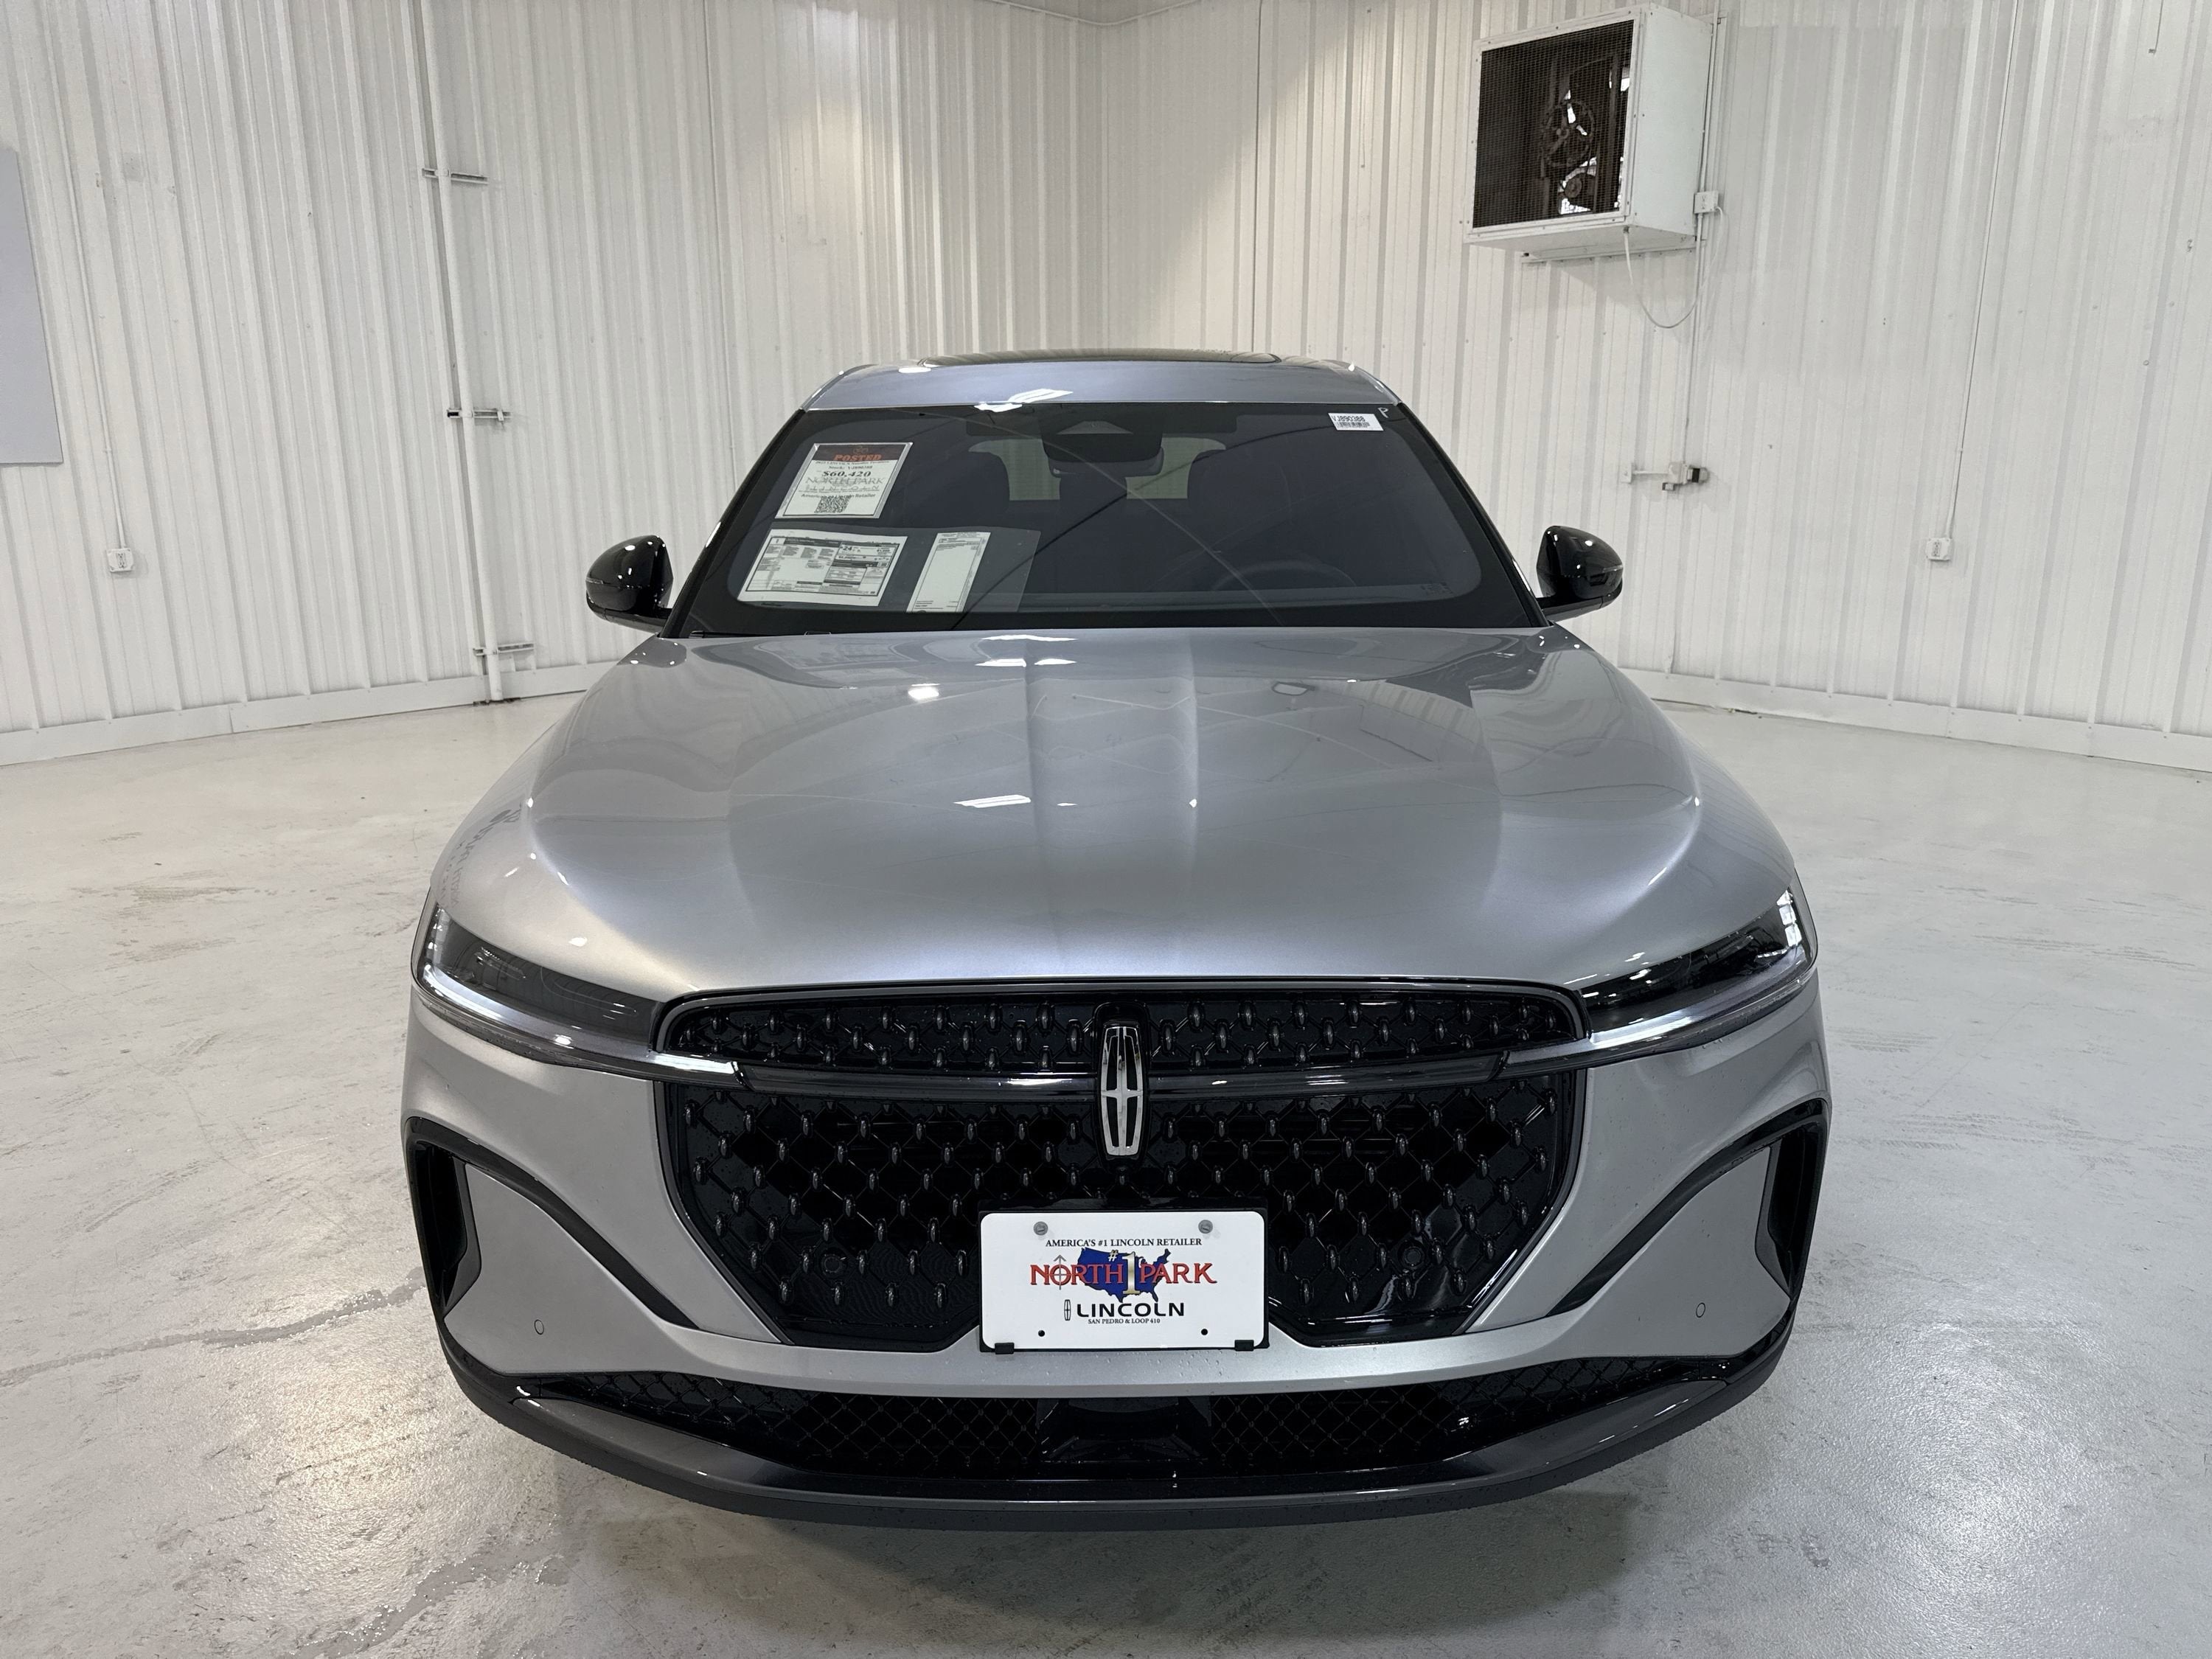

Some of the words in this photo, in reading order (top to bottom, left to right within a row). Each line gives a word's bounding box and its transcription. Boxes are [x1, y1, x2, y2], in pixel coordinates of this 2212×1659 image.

[1046, 1239, 1096, 1247] AMERICA'S
[1110, 1239, 1155, 1247] LINCOLN
[1157, 1238, 1202, 1246] RETAILER
[1031, 1263, 1124, 1285] NORTH
[1140, 1263, 1217, 1284] PARK
[1077, 1303, 1184, 1317] LINCOLN
